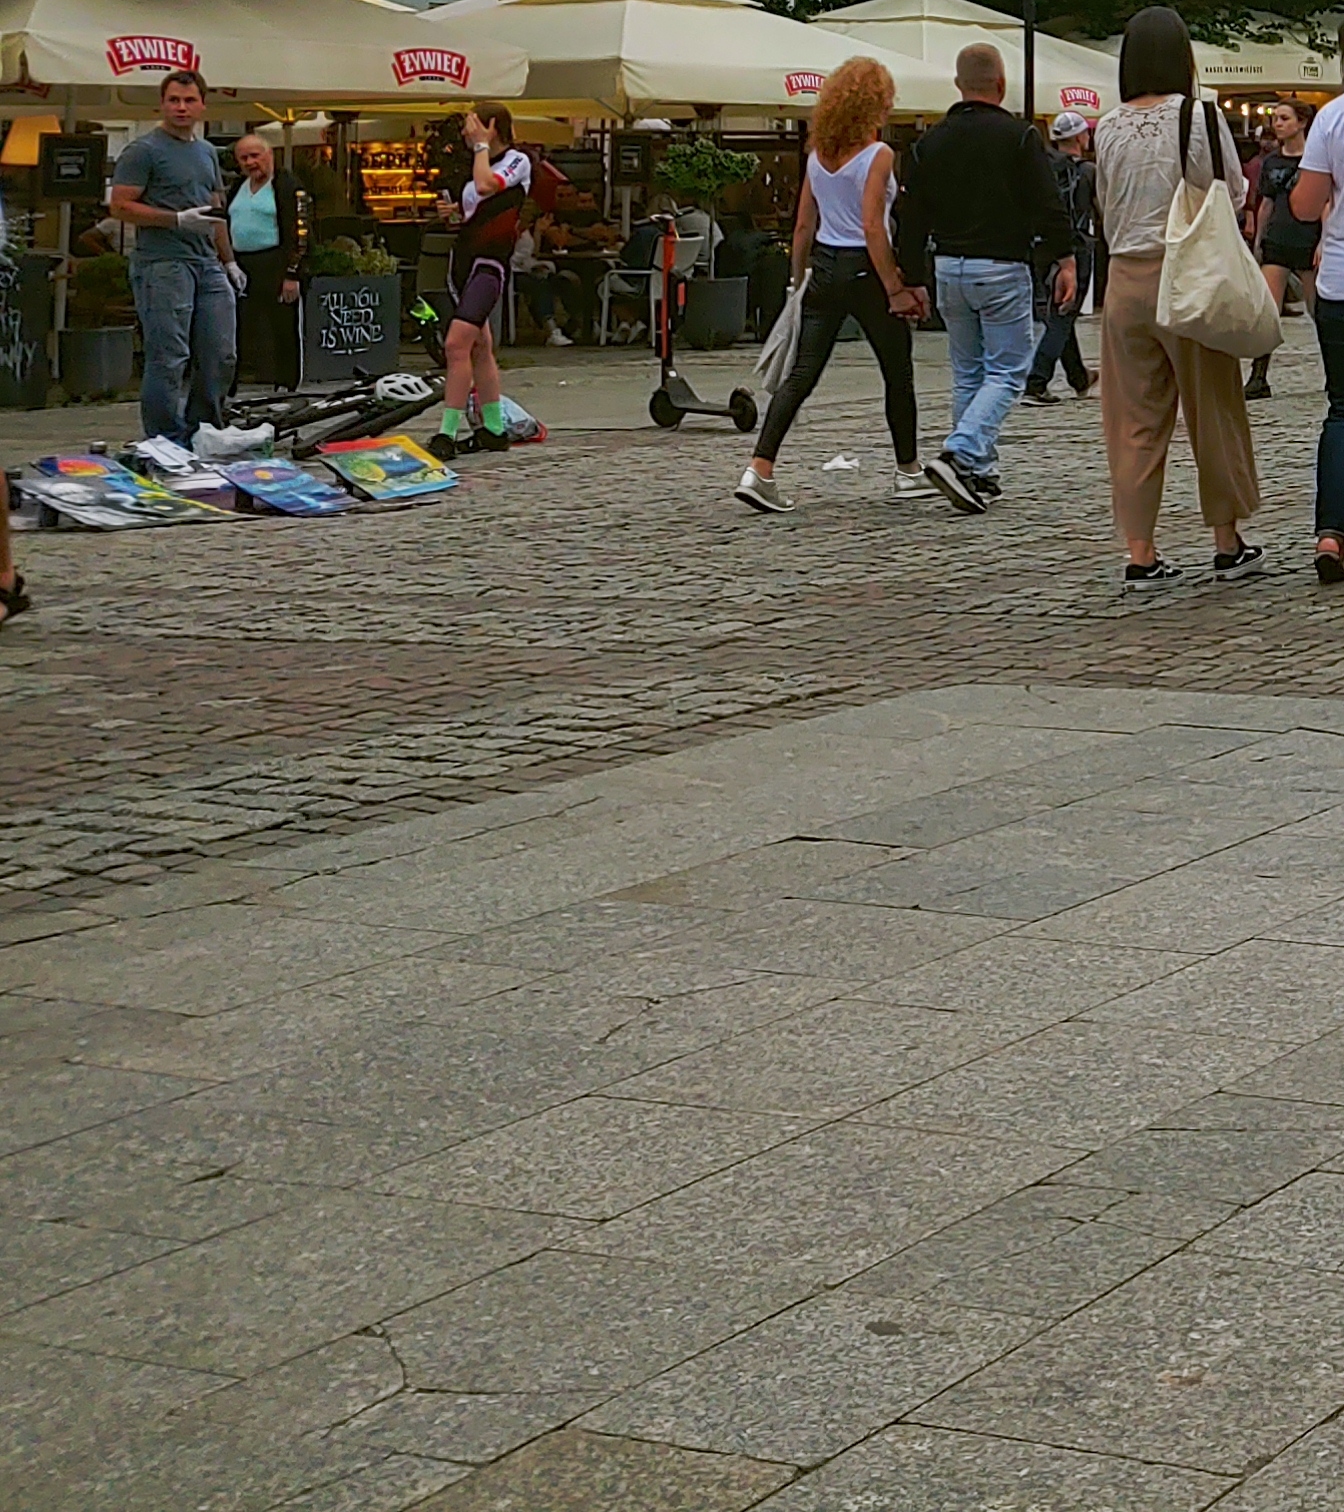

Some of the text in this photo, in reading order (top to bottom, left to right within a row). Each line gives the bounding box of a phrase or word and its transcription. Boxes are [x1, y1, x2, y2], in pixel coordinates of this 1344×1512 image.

[115, 38, 188, 64] ŻYWIEC
[401, 51, 461, 76] ŻYWIEC
[321, 324, 385, 348] IS WINE
